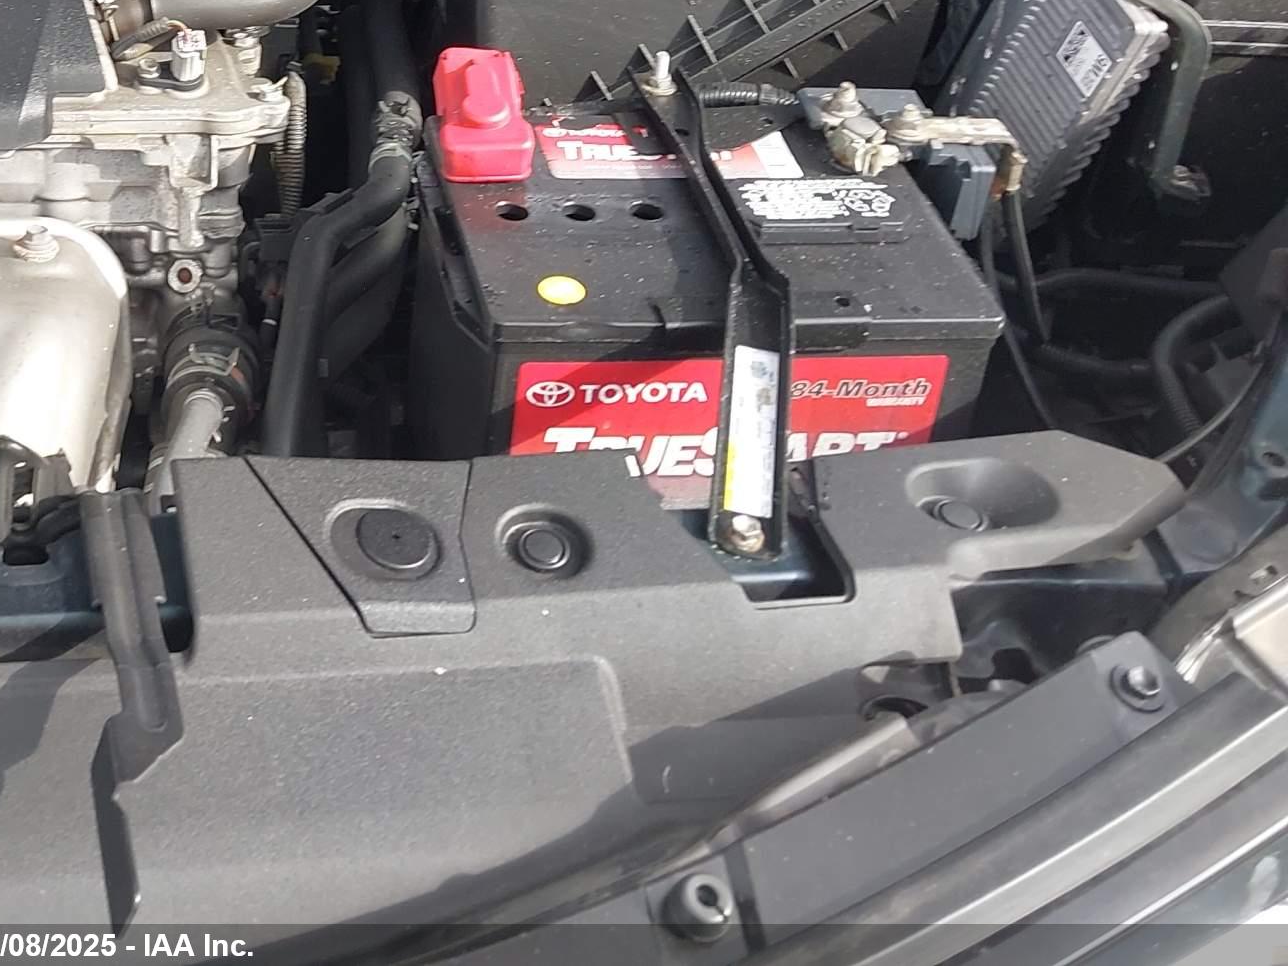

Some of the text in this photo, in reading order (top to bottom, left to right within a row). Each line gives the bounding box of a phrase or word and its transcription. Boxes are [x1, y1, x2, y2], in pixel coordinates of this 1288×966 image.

[579, 382, 708, 404] TOYOTA
[791, 377, 932, 399] 84-Month
[544, 427, 897, 477] TRUESART
